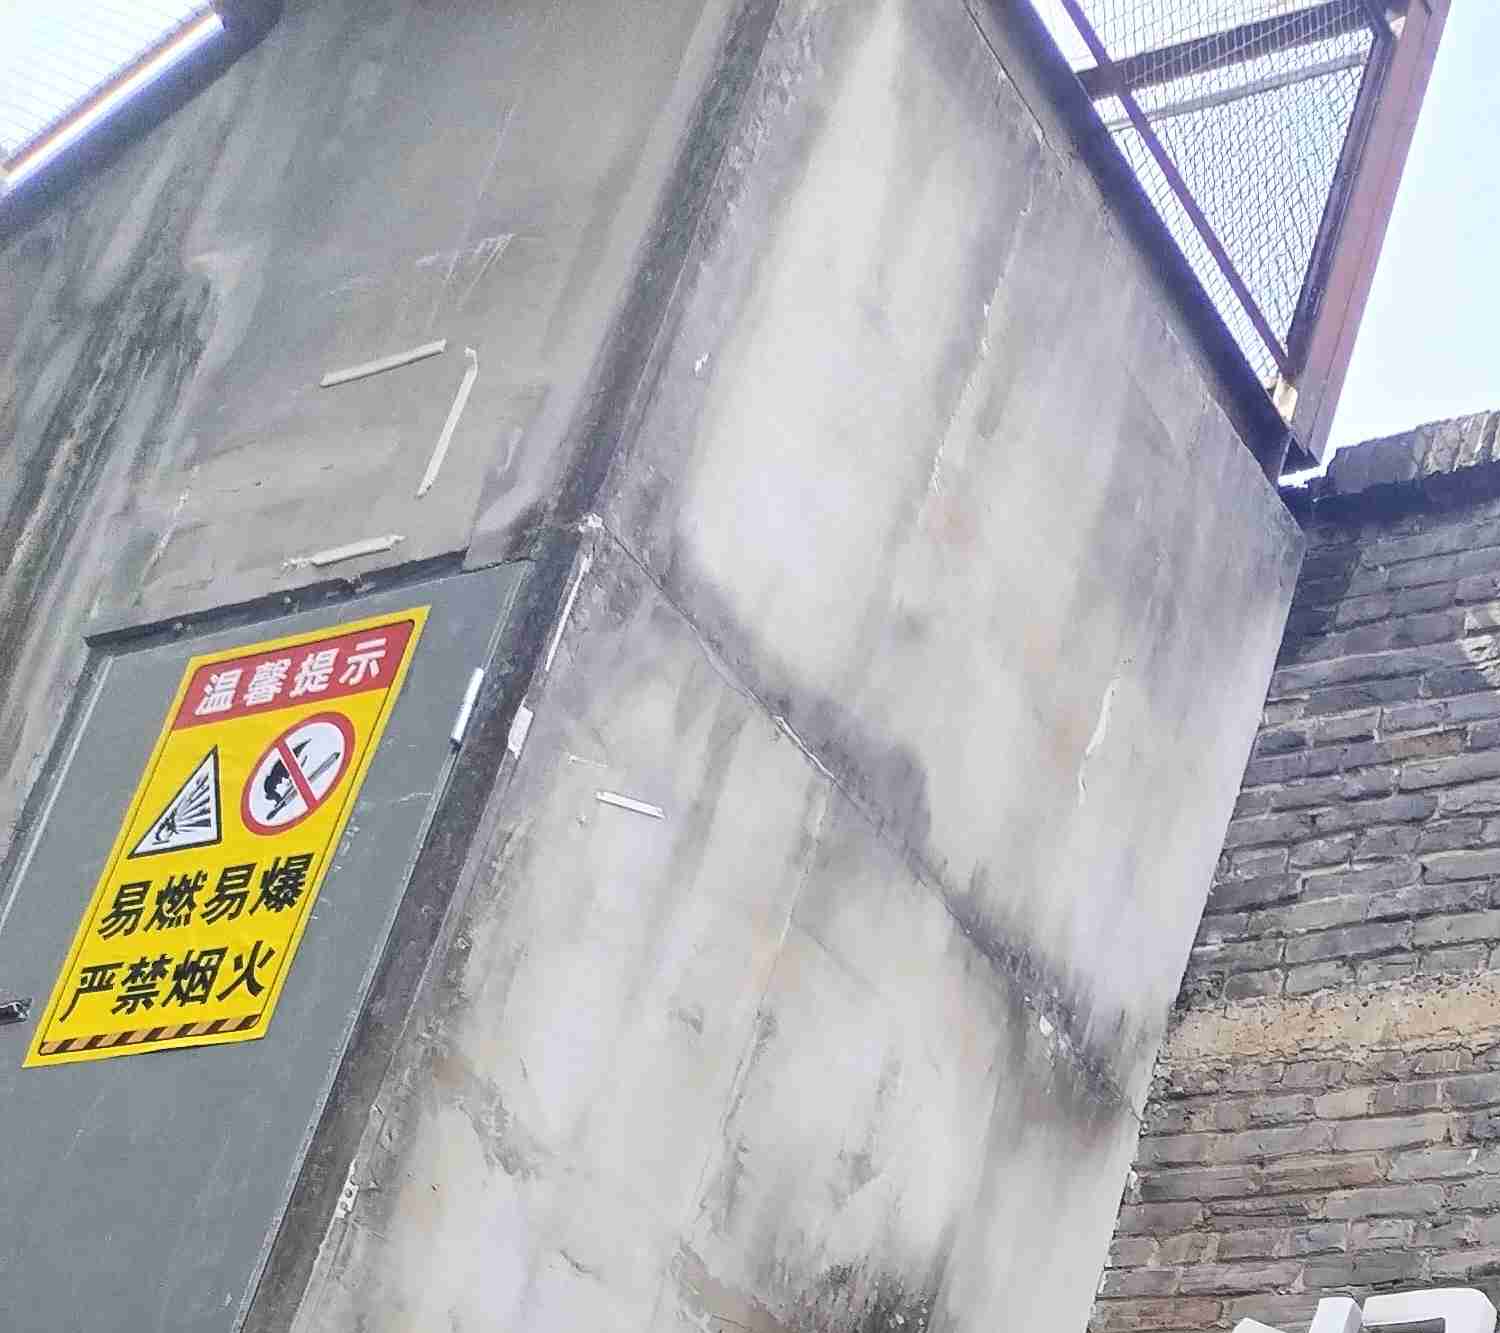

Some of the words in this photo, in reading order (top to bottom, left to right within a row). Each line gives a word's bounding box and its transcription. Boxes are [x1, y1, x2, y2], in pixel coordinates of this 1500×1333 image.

[195, 637, 386, 715] 温馨提示
[98, 853, 314, 940] 易燃易爆
[59, 940, 275, 1023] 严禁烟火
